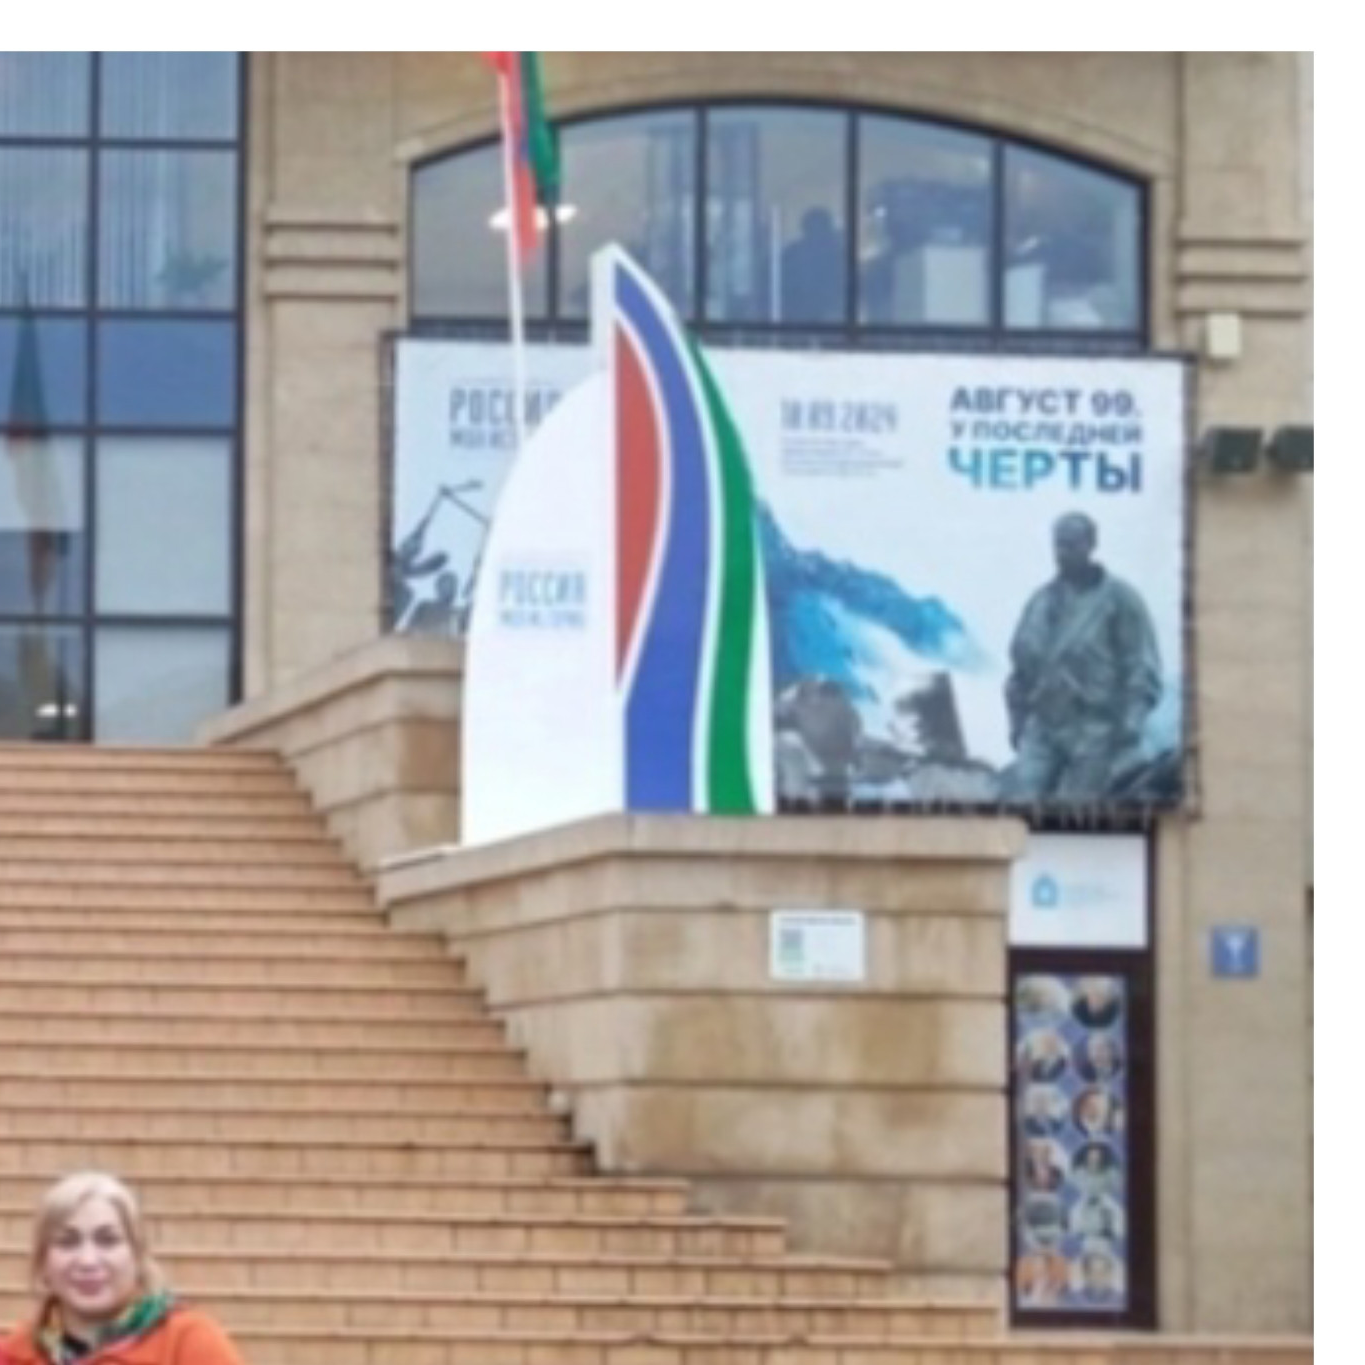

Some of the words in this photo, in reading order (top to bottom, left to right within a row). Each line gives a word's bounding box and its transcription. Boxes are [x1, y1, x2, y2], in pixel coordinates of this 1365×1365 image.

[950, 386, 1082, 415] АВГУСТ
[1091, 388, 1143, 417] 99.
[950, 420, 967, 442] У
[972, 420, 1143, 446] ПОСЛЕДНЕЙ
[949, 447, 1143, 494] ЧЕРТЫ
[499, 569, 586, 605] РОССИЯ
